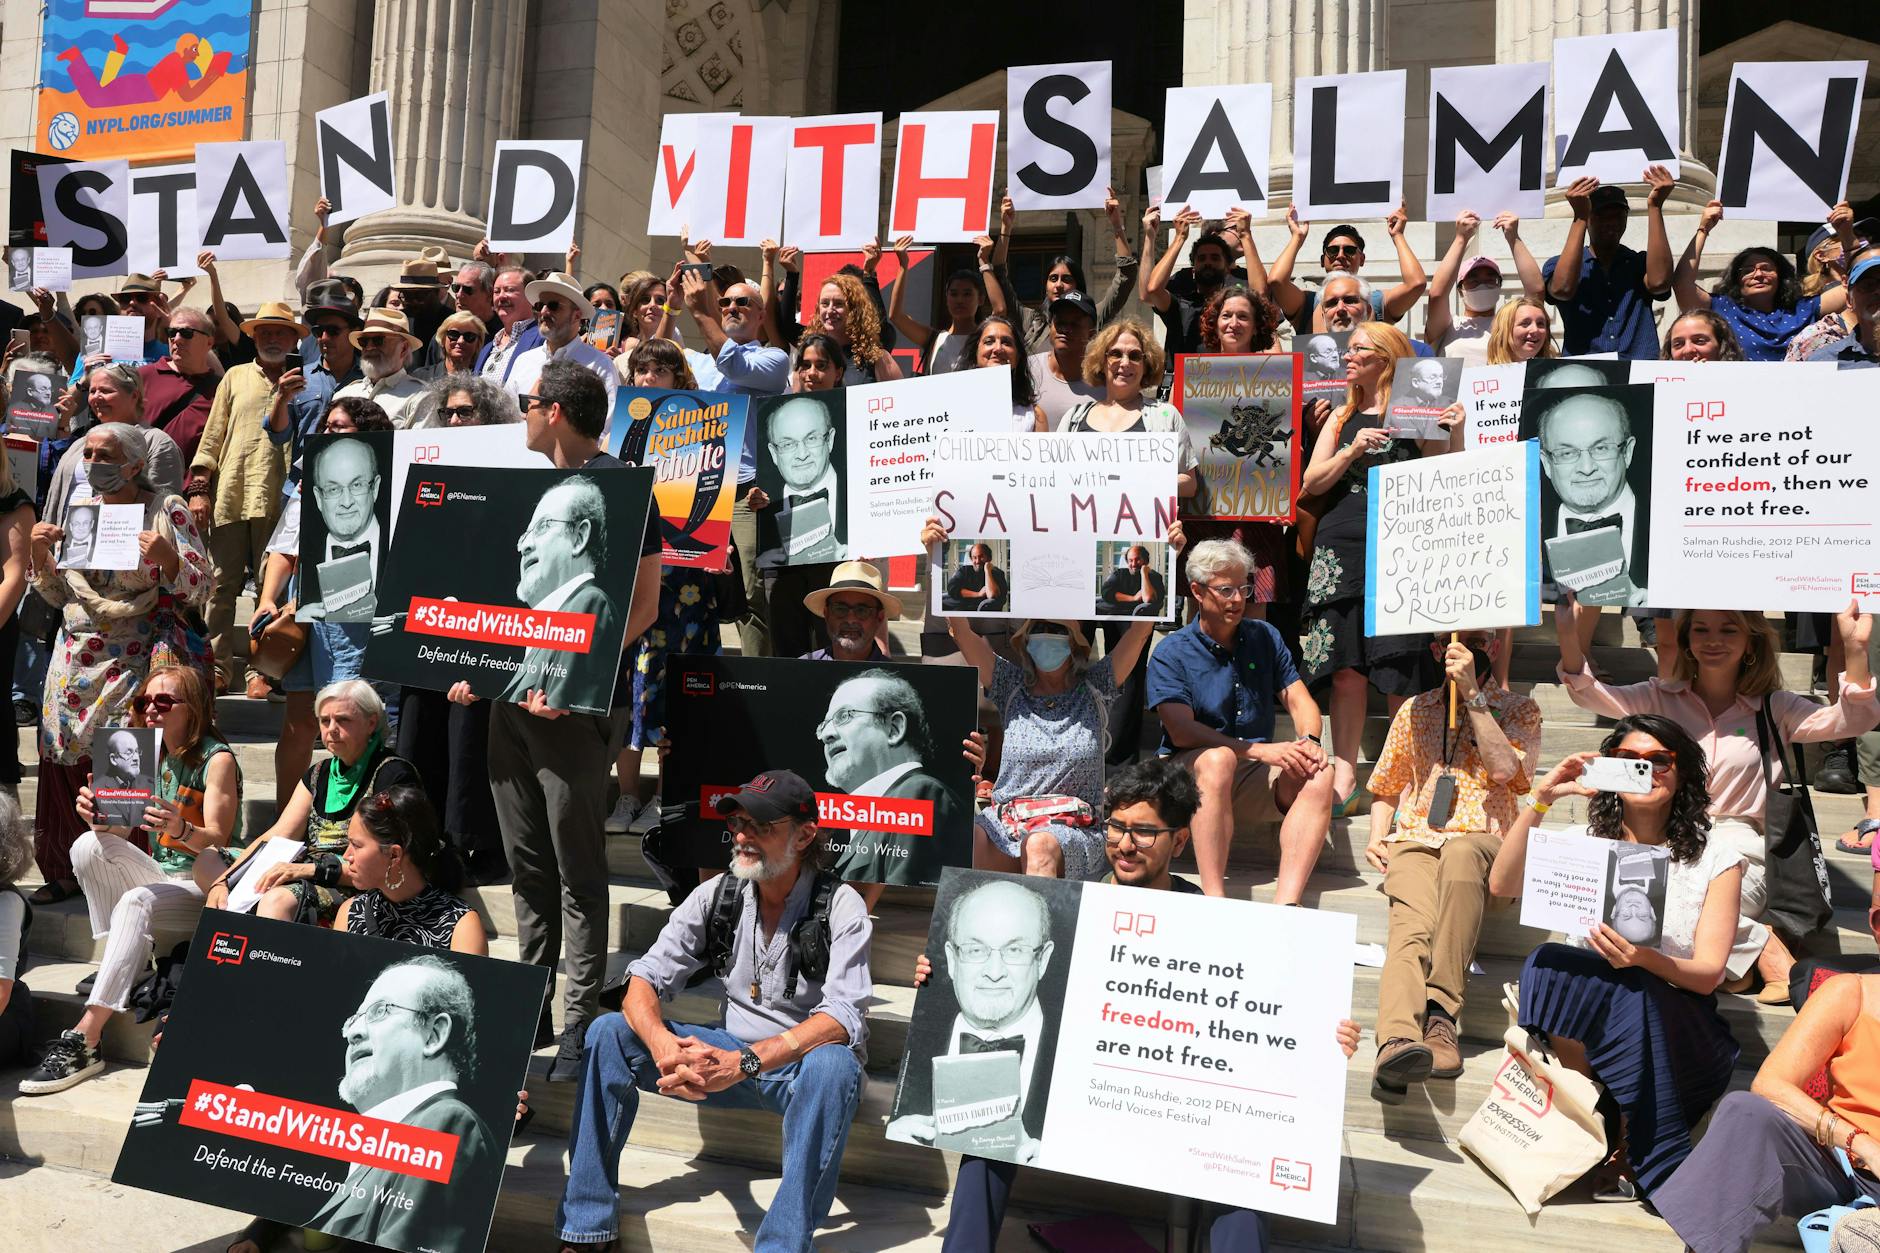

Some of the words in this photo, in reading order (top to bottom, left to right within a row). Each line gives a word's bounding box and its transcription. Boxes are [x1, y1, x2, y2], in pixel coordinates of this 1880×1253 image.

[86, 105, 232, 135] NYPL.ORG/SUMMER
[1186, 358, 1211, 378] The
[1185, 375, 1241, 403] Satanic
[1235, 355, 1291, 398] Verses
[1476, 400, 1485, 411] If
[1489, 401, 1506, 409] we
[654, 401, 728, 433] Salman
[869, 419, 879, 431] If
[882, 421, 900, 429] we
[903, 417, 924, 427] are
[928, 411, 949, 424] not
[648, 420, 728, 459] Rushdie
[869, 432, 931, 449] confident
[1687, 430, 1701, 445] If
[1706, 431, 1733, 444] we
[1739, 430, 1772, 443] are
[1778, 426, 1813, 442] not
[870, 452, 929, 467] freedom,
[938, 437, 1032, 462] CHILDREN'S
[1039, 438, 1077, 463] BOOK
[1083, 438, 1175, 463] WRITERS
[1686, 452, 1781, 468] confident
[1787, 450, 1810, 466] of
[1816, 452, 1852, 465] our
[870, 476, 891, 486] are
[894, 470, 916, 483] not
[1385, 471, 1423, 499] PEN
[1429, 466, 1515, 492] America's
[1685, 476, 1777, 493] freedom,
[1783, 475, 1832, 490] then
[1838, 477, 1869, 489] we
[447, 491, 487, 501] @PENamerica
[870, 500, 895, 509] Salman
[1383, 492, 1465, 521] Children's
[1473, 485, 1506, 505] and
[870, 509, 891, 518] World
[893, 508, 914, 516] Voices
[1684, 504, 1715, 516] are
[1721, 501, 1754, 516] not
[1761, 500, 1811, 516] free.
[1382, 517, 1434, 540] Young
[1437, 511, 1473, 531] Adult
[1477, 503, 1521, 526] Book
[1411, 532, 1486, 552] Commitee
[1683, 536, 1719, 546] Salman
[1722, 536, 1766, 547] Rushdie,
[1768, 537, 1793, 546] 2012
[1795, 537, 1820, 546] PEN
[1824, 537, 1872, 546] America
[1386, 545, 1510, 579] Supports
[1683, 549, 1713, 559] World
[1716, 549, 1750, 559] Voices
[1752, 549, 1793, 559] Festival
[415, 605, 586, 644] #StandWithSalman
[417, 645, 460, 664] Defend
[459, 650, 478, 666] the
[479, 653, 525, 673] Freedom
[526, 660, 538, 674] to
[540, 661, 568, 678] Write
[719, 681, 767, 691] @PENamerica
[855, 843, 869, 855] to
[873, 842, 909, 858] Write
[1543, 879, 1561, 888] then
[1561, 892, 1597, 903] confident
[213, 946, 240, 957] AMERICA
[215, 939, 229, 947] PEN
[249, 949, 302, 967] @PENamerica
[1110, 945, 1127, 963] If
[1132, 953, 1161, 968] we
[1166, 959, 1202, 974] are
[1208, 963, 1245, 980] not
[1105, 978, 1209, 1006] confident
[1215, 991, 1240, 1010] of
[1244, 1000, 1283, 1016] our
[1101, 1002, 1201, 1038] freedom,
[1208, 1020, 1259, 1045] then
[1265, 1034, 1297, 1051] we
[1096, 1039, 1131, 1056] are
[1137, 1045, 1174, 1063] not
[1180, 1046, 1234, 1073] free.
[1510, 1063, 1531, 1083] PEN
[1503, 1072, 1544, 1107] AMERICA
[1088, 1095, 1122, 1112] World
[1126, 1101, 1163, 1119] Voices
[1166, 1108, 1212, 1127] Festival
[1089, 1078, 1131, 1095] Salman
[1133, 1085, 1183, 1105] Rushdie,
[1186, 1096, 1212, 1110] 2012
[1215, 1099, 1243, 1114] PEN
[1245, 1105, 1296, 1124] America
[194, 1091, 443, 1171] #StandWithSalman
[1494, 1123, 1530, 1150] INSTITUTE
[193, 1145, 252, 1172] Defend
[251, 1155, 277, 1179] the
[279, 1164, 348, 1196] Freedom
[350, 1182, 367, 1200] to
[372, 1185, 415, 1210] Write
[1275, 1172, 1307, 1183] AMERICA
[1276, 1165, 1290, 1173] PEN
